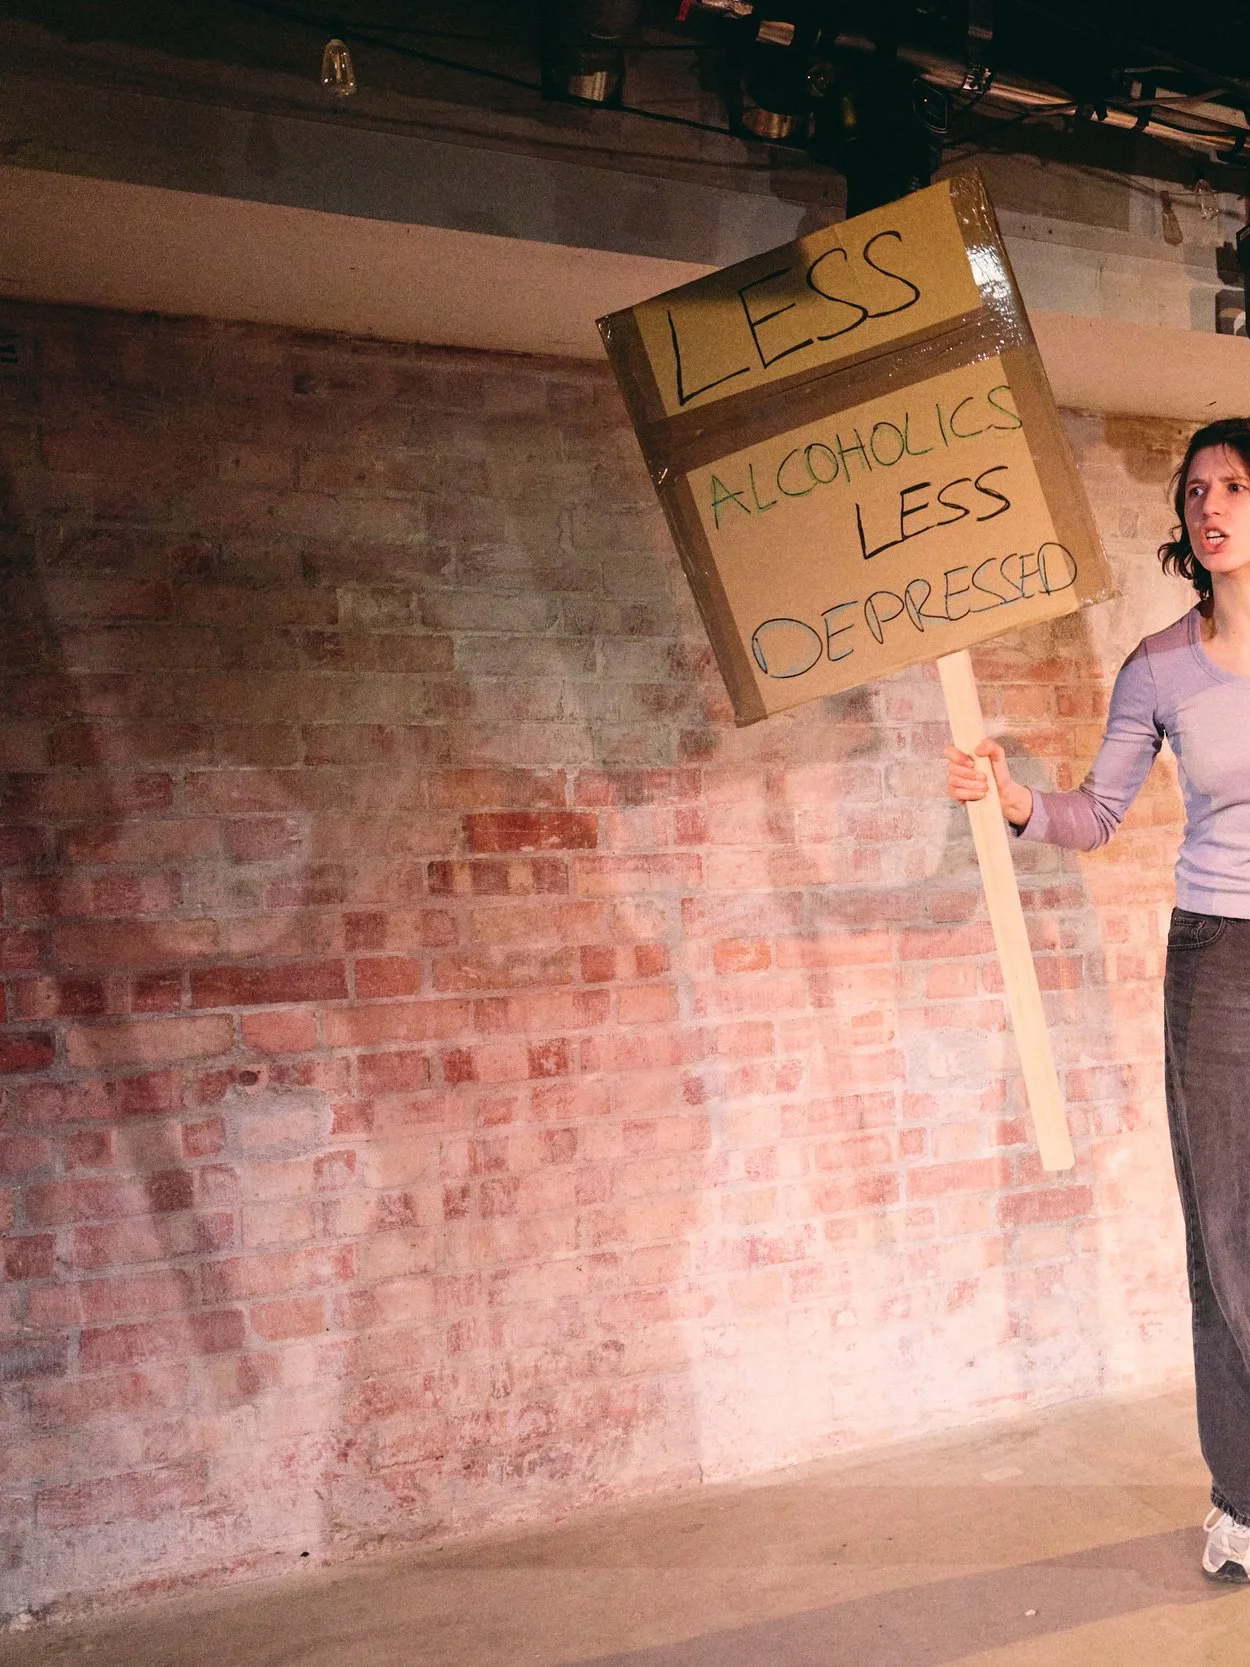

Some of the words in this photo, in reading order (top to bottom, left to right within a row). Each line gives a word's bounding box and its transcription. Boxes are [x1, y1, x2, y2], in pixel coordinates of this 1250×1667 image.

[666, 230, 921, 407] LESS
[709, 385, 1024, 529] ALCOHOLICS
[855, 465, 1012, 560] LESS
[751, 542, 1079, 679] DEPRESSED
